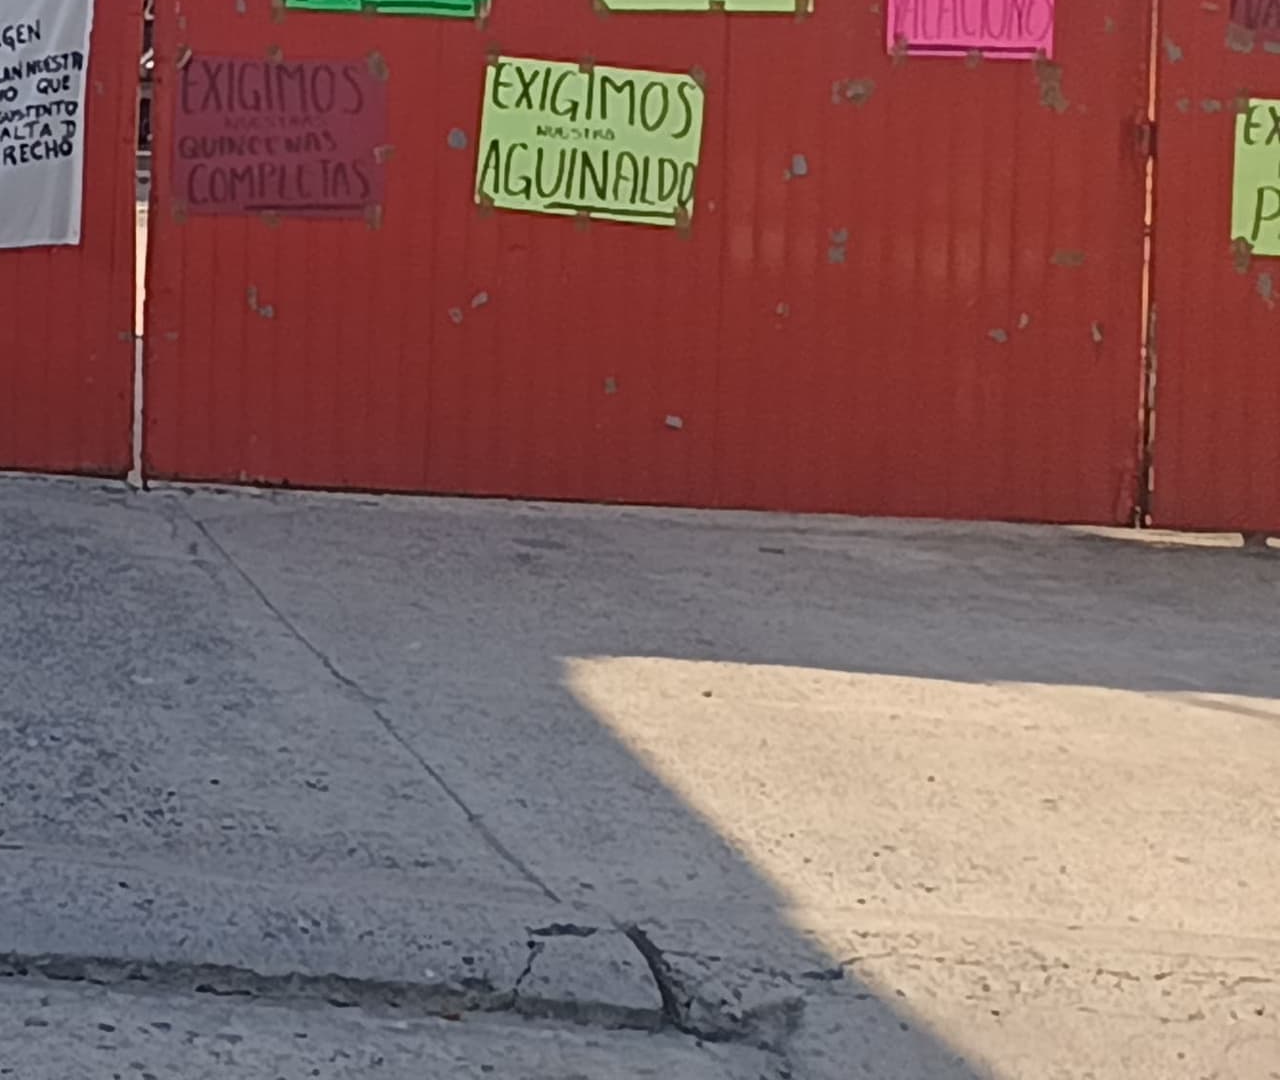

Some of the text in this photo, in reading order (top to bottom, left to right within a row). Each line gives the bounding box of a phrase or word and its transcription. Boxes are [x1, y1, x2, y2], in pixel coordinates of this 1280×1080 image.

[36, 75, 71, 95] QUE
[181, 58, 364, 115] EXIGIMOS
[492, 61, 697, 140] EXIGIMOS
[179, 130, 337, 160] QUINCENAS
[189, 159, 371, 205] COMPLETAS
[479, 138, 697, 207] AGUINALDO
